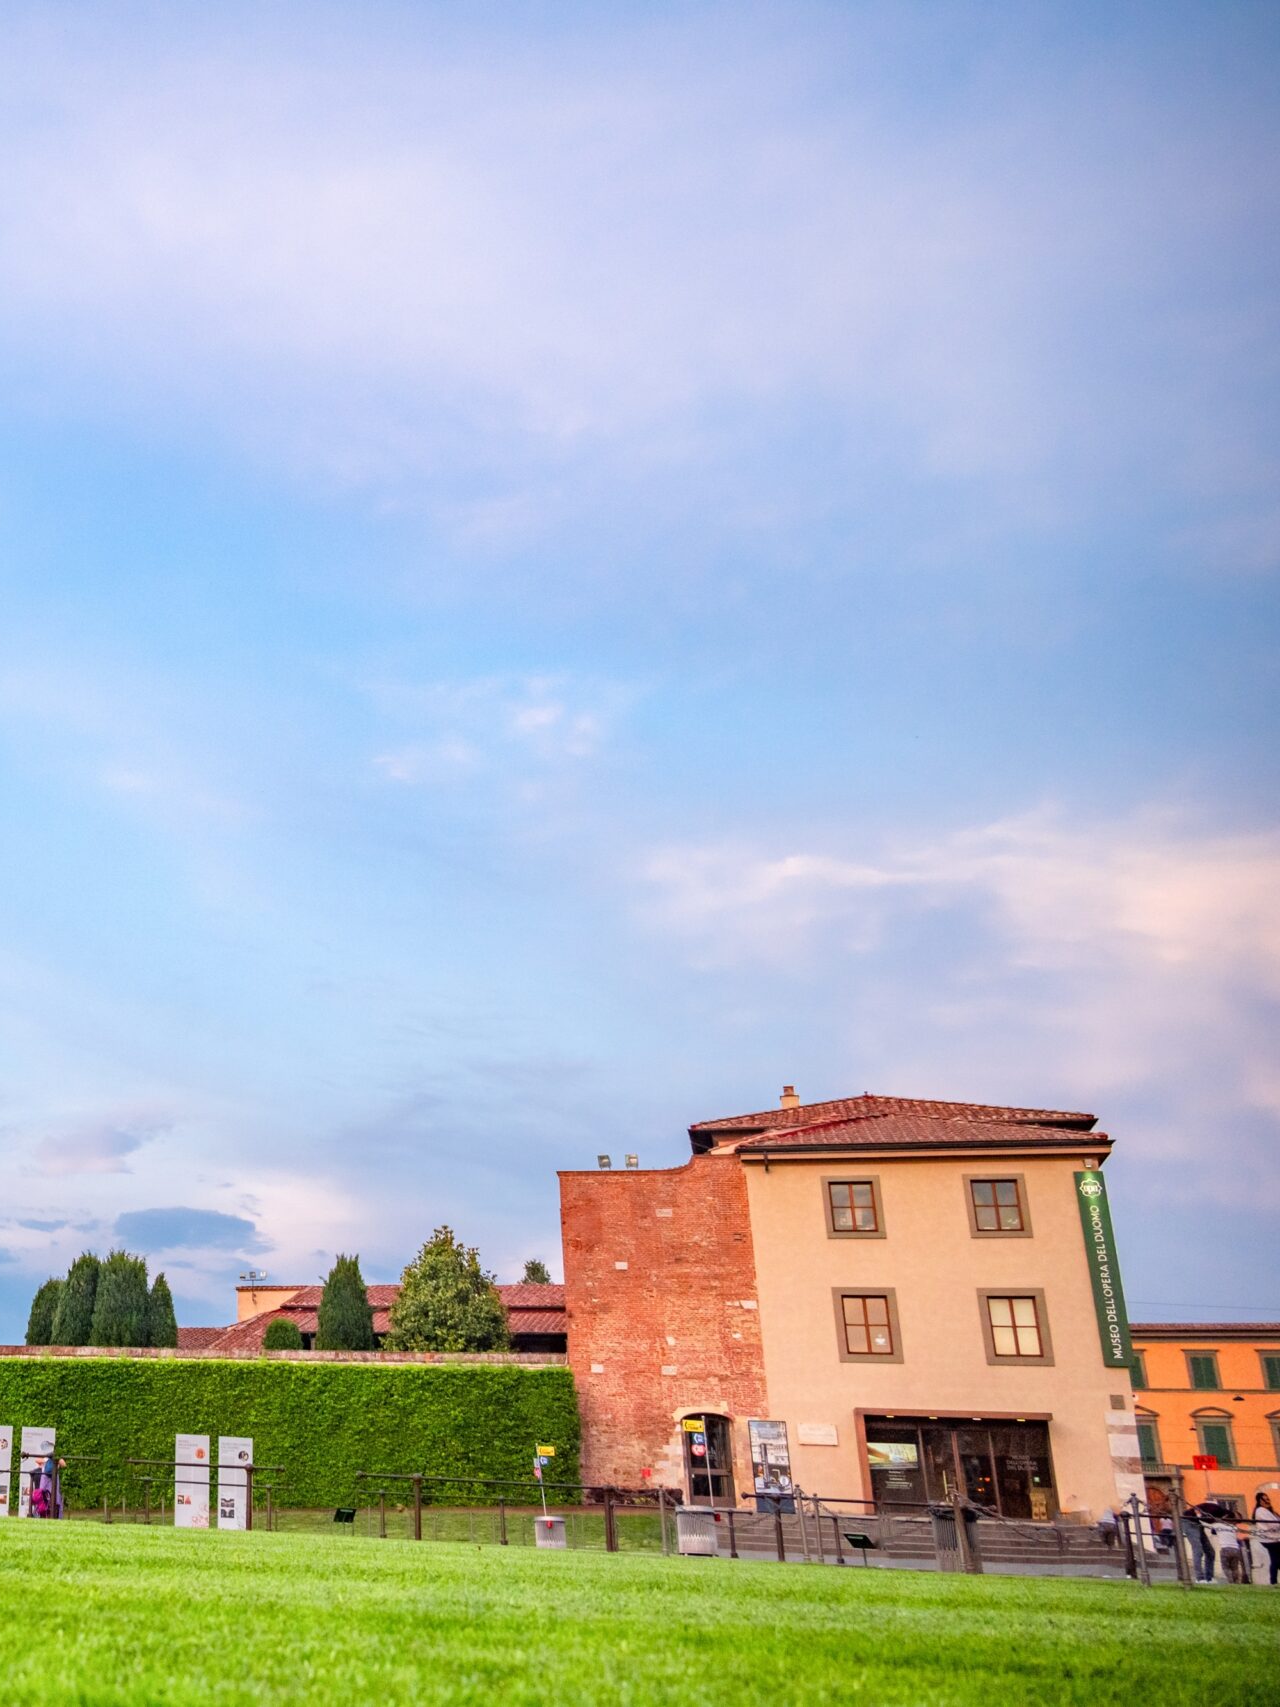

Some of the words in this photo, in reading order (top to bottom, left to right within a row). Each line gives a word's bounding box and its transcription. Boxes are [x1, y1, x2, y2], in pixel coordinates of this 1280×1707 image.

[1089, 1205, 1104, 1242] DUOMO
[1096, 1244, 1107, 1262] DEL
[1099, 1264, 1118, 1322] DELL'OPERA
[1109, 1324, 1123, 1359] MUSEO
